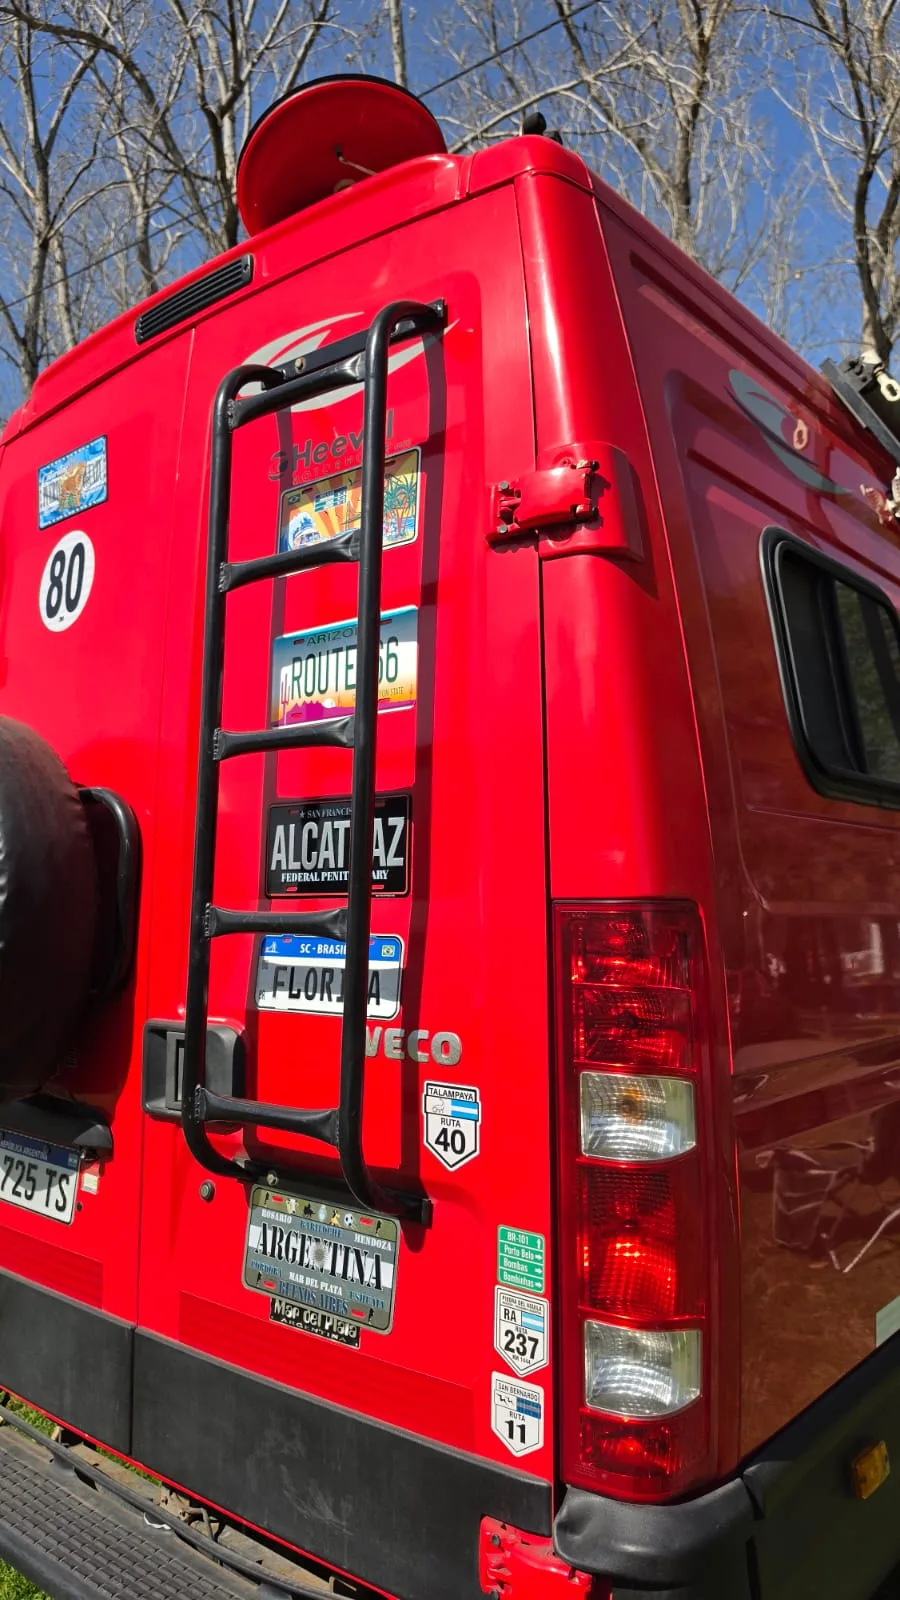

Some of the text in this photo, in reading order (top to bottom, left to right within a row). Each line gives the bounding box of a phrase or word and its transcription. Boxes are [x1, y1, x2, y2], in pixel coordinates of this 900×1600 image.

[292, 409, 394, 472] Heevl
[46, 542, 85, 619] 80
[307, 627, 358, 647] ARIZO
[291, 645, 357, 700] ROUTE
[307, 808, 353, 818] SAN FRANCIS
[270, 816, 405, 871] ALCATAZ
[281, 869, 389, 882] FEDERAL PENITARY
[299, 943, 311, 954] SC
[272, 966, 380, 1006] FLORIA
[364, 1026, 462, 1066] VECO
[429, 1087, 474, 1101] TALAMPAYA
[440, 1117, 461, 1128] RUTA
[434, 1127, 466, 1155] 40
[1, 1155, 70, 1212] 725 TS
[261, 1208, 293, 1224] ROSARIO
[354, 1233, 392, 1251] MENDOZA
[507, 1231, 529, 1245] BR-101
[254, 1221, 384, 1291] ARGENTINA
[503, 1257, 528, 1272] Bombas
[504, 1244, 535, 1260] Porto Belo
[289, 1271, 343, 1296] MAR DEL PLATA
[503, 1271, 534, 1288] Bombinhas
[274, 1299, 300, 1319] Mar
[278, 1279, 317, 1304] BUENOS
[320, 1294, 349, 1315] AIRES
[503, 1308, 517, 1322] RA
[281, 1318, 347, 1343] ARGENTINA
[504, 1329, 539, 1360] 237
[498, 1382, 538, 1402] SAN BERNARDO
[509, 1410, 526, 1422] RUTA
[504, 1419, 526, 1445] 11
